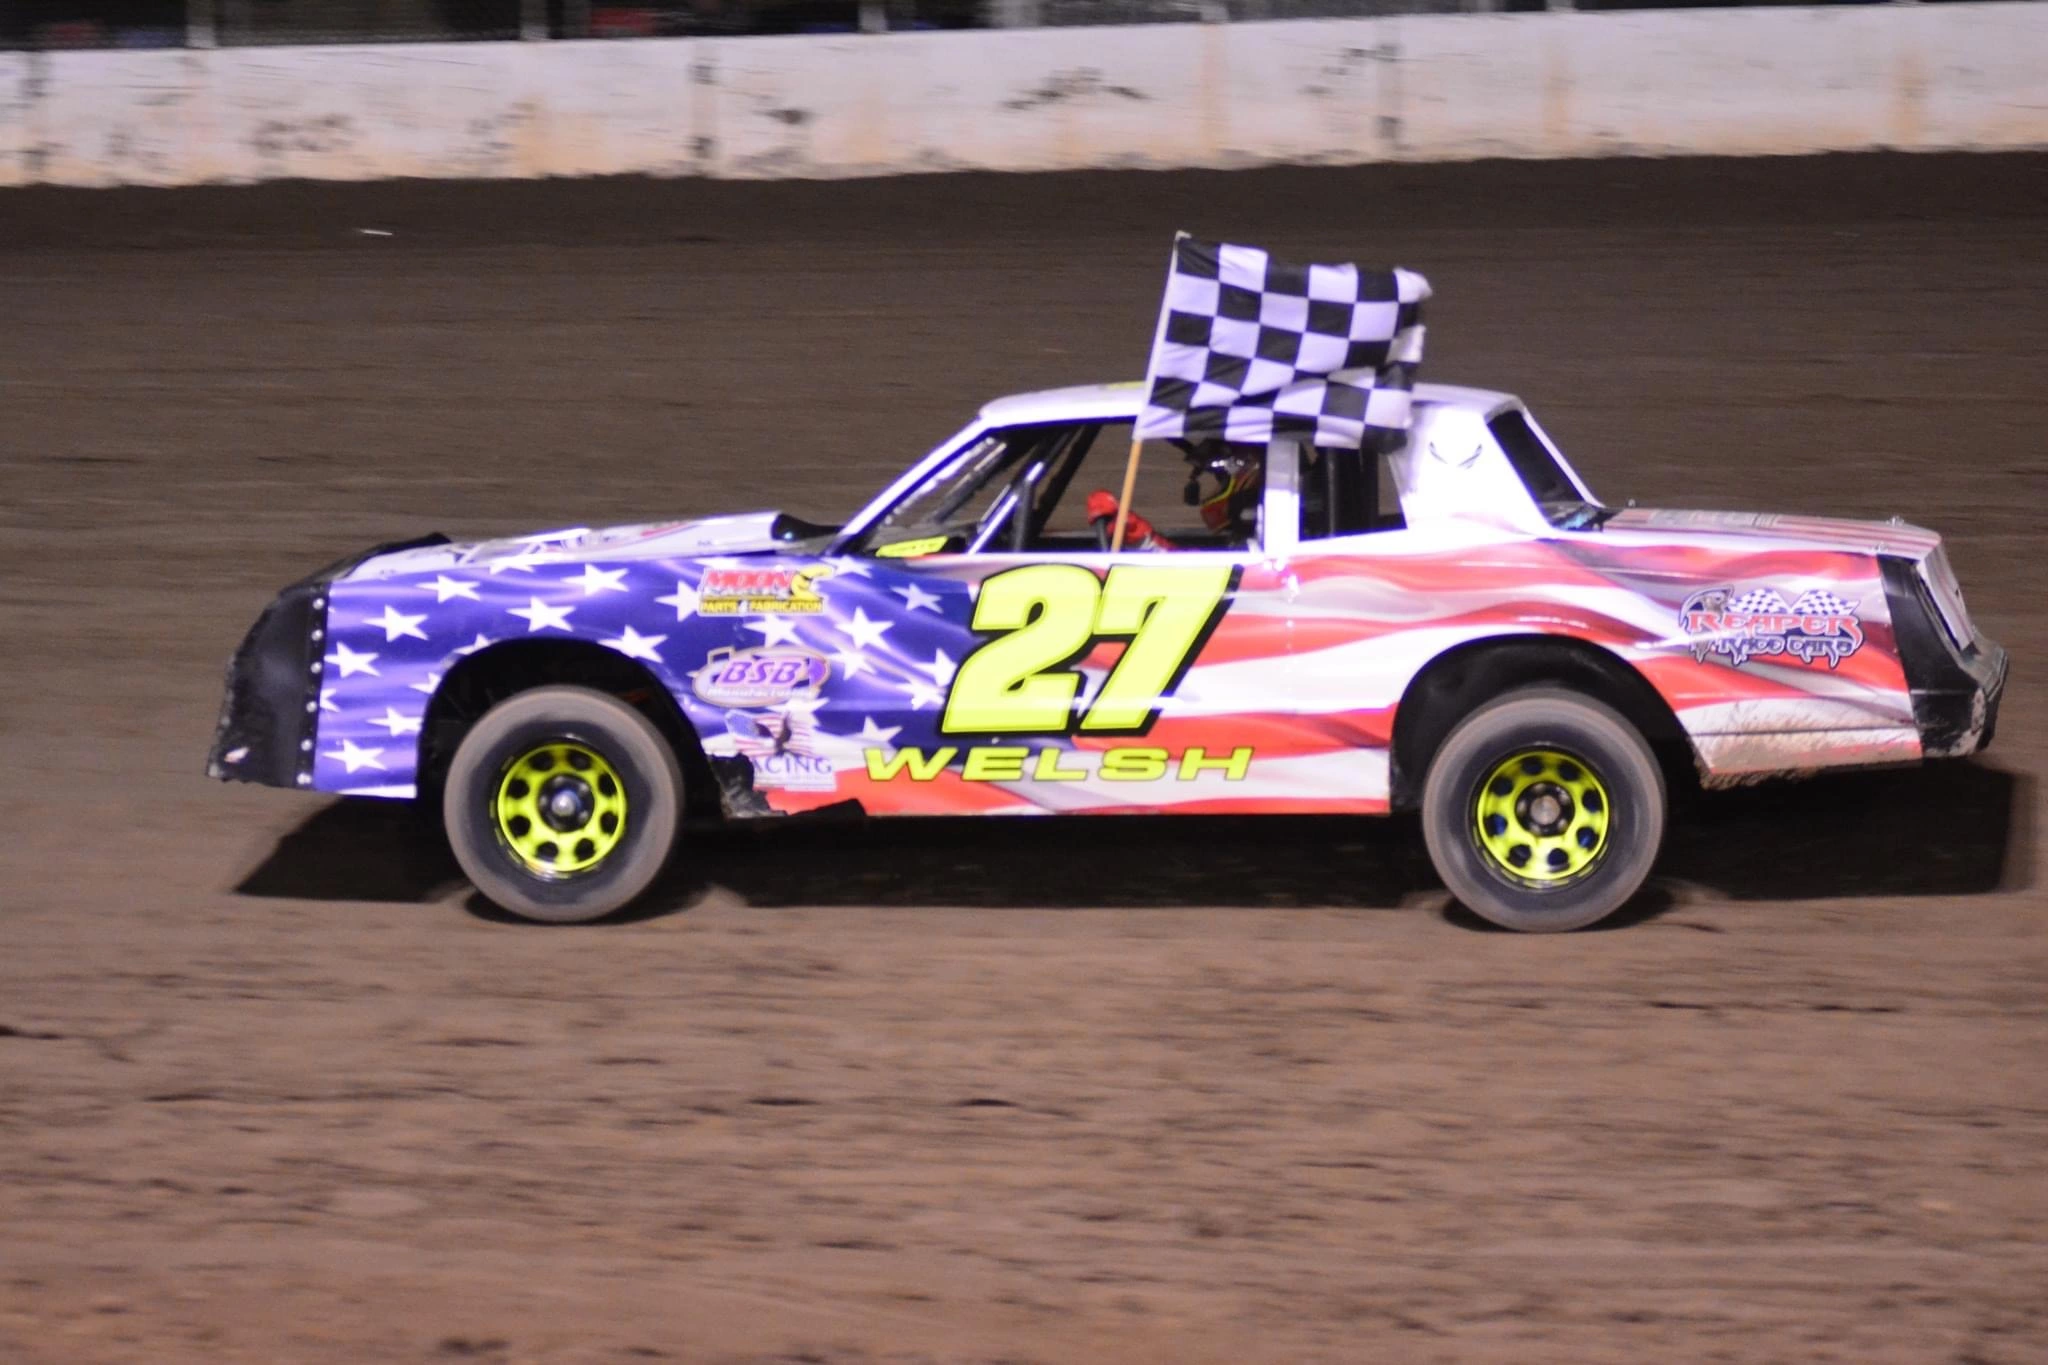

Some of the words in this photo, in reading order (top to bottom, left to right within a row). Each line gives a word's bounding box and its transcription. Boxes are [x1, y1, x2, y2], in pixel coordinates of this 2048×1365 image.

[1687, 612, 1862, 645] REAPER
[942, 563, 1239, 737] 27
[719, 660, 803, 685] BSB
[862, 746, 1255, 782] WELSH
